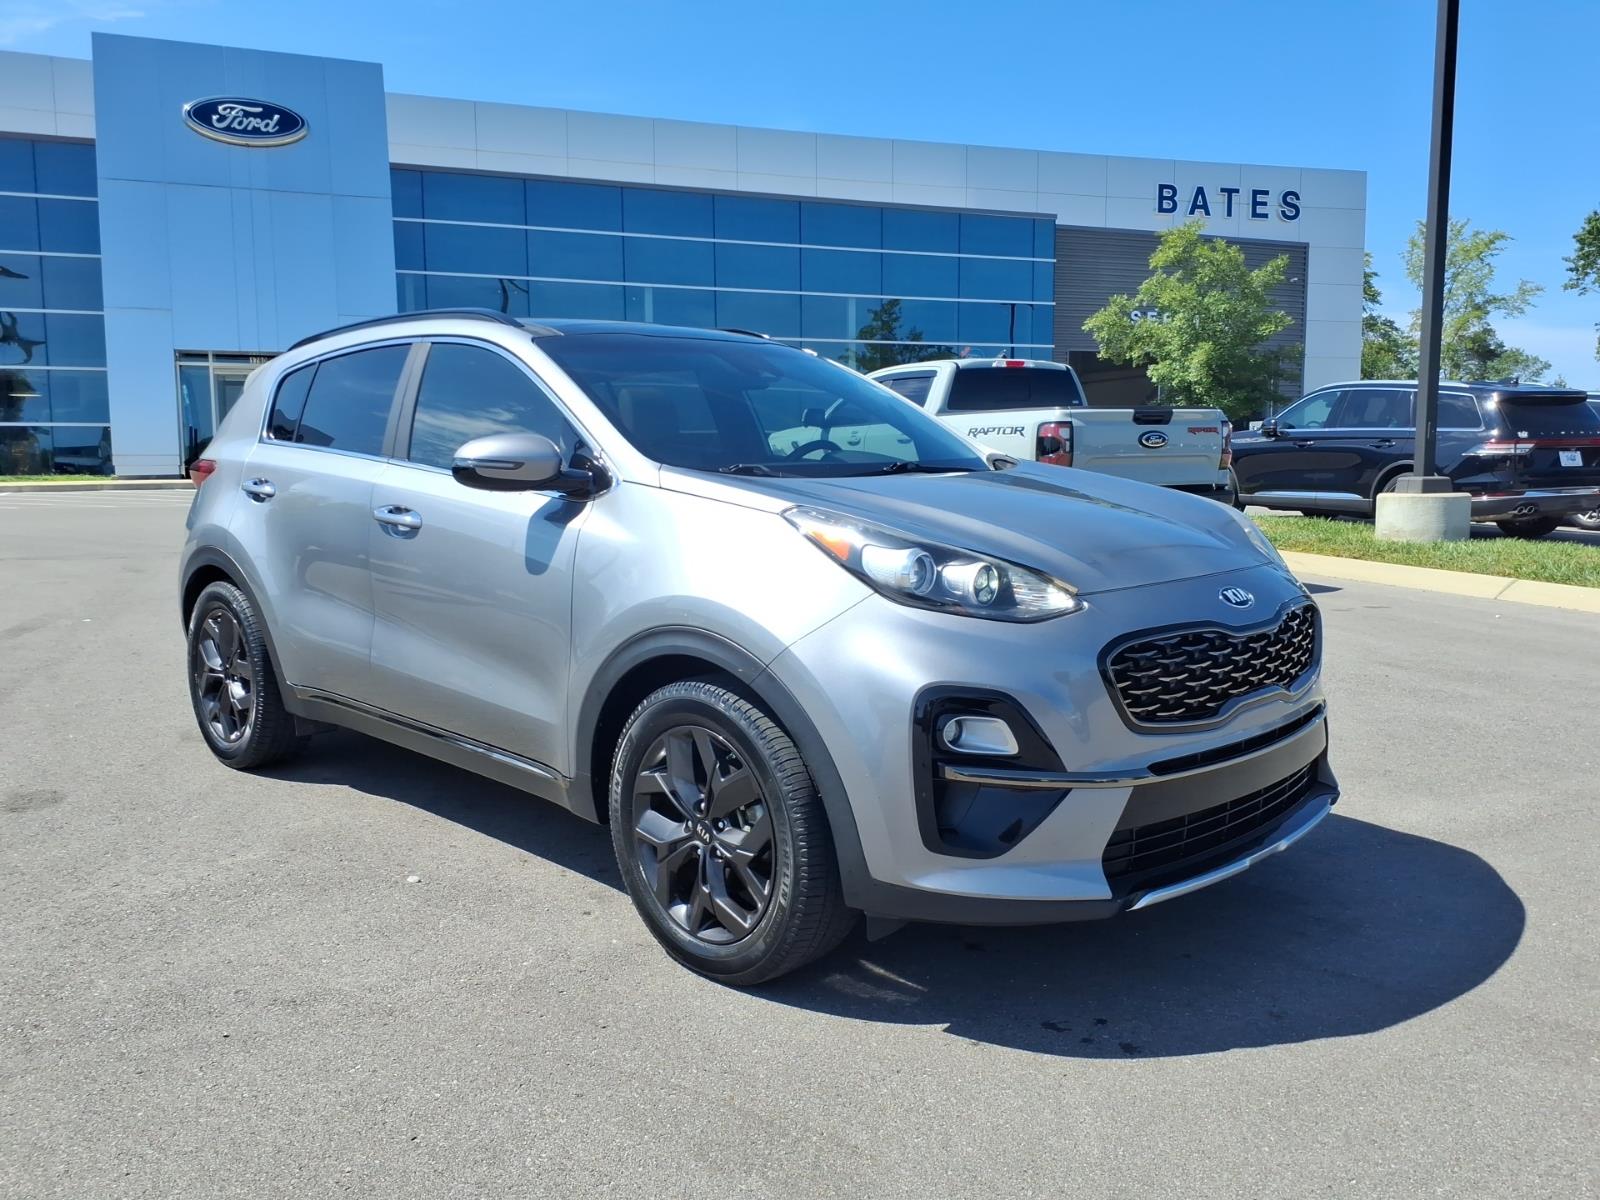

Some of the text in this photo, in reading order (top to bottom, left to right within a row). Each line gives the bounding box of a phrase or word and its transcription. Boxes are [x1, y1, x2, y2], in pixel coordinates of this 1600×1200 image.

[211, 103, 280, 132] Ford
[1156, 183, 1301, 221] BATES
[967, 426, 1025, 438] RAPTOR
[1222, 587, 1251, 603] KIA
[696, 823, 710, 843] KIA
